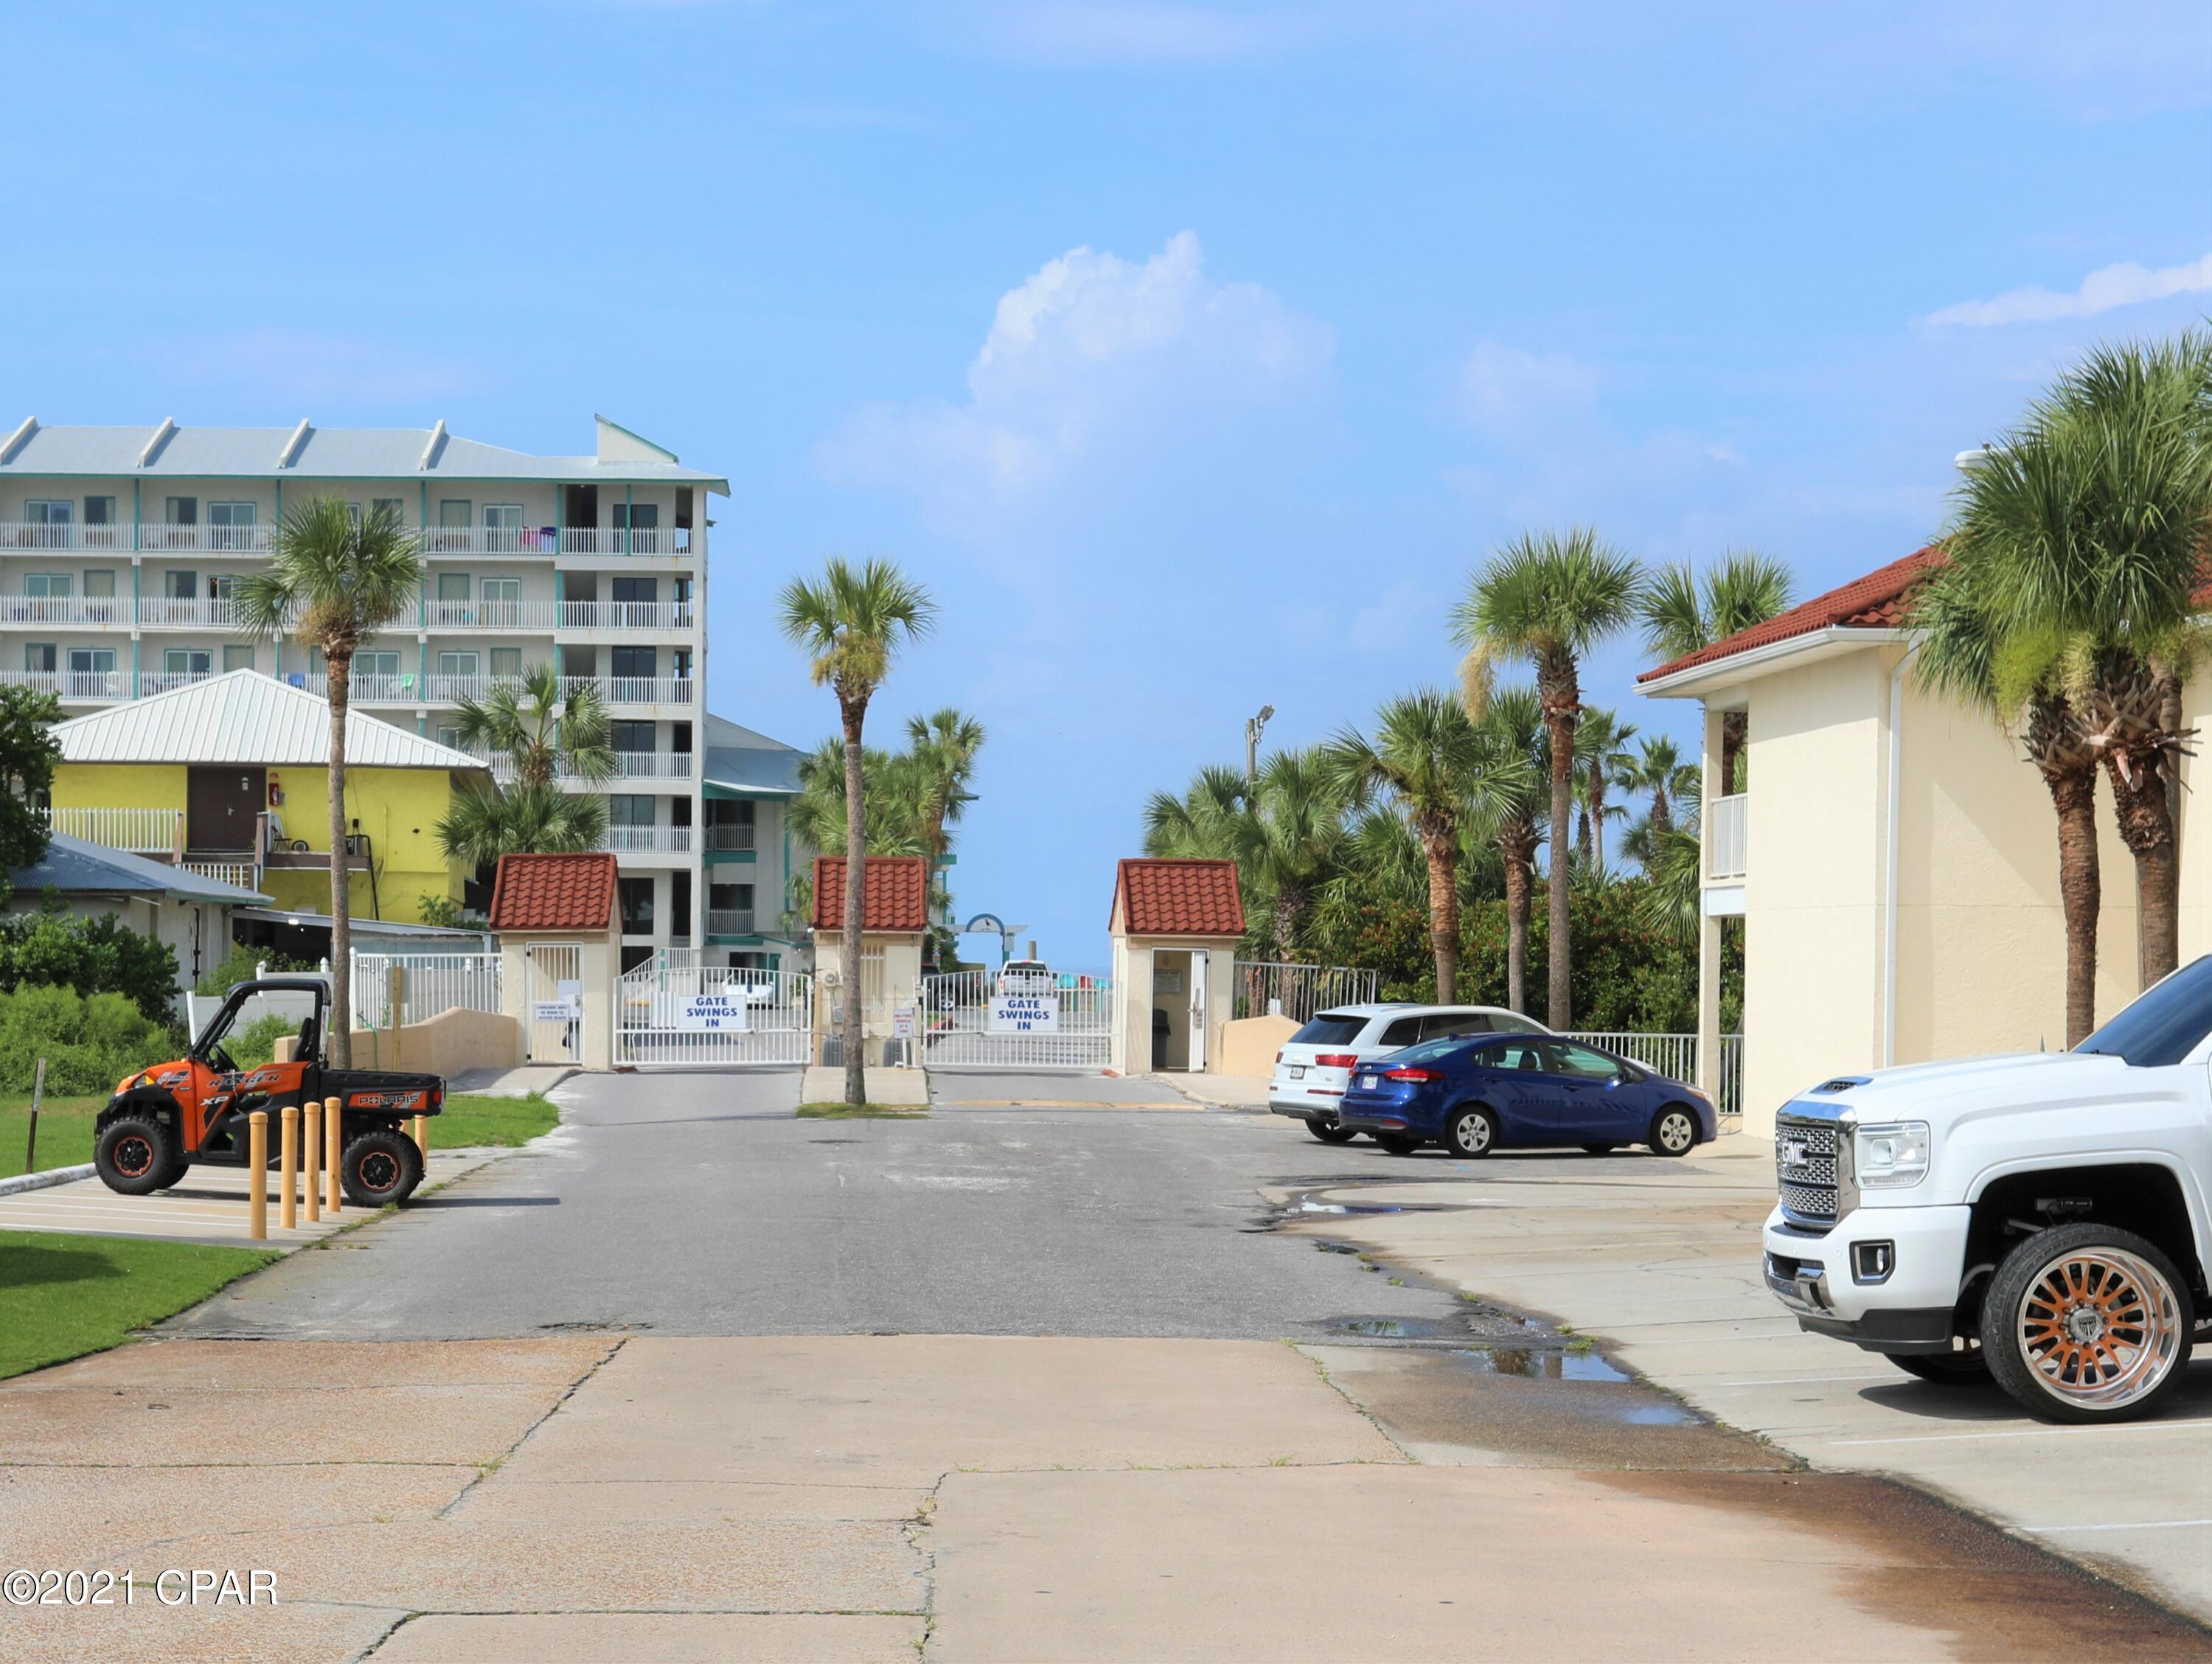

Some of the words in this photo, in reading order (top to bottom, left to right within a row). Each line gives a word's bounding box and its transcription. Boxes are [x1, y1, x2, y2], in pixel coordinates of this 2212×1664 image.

[696, 997, 728, 1006] GATE
[1008, 1000, 1040, 1009] GATE
[686, 1008, 737, 1017] SWINGS
[998, 1010, 1049, 1020] SWINGS
[706, 1019, 719, 1027] IN
[1018, 1021, 1031, 1030] IN
[207, 1074, 281, 1088] RANGER
[200, 1096, 229, 1106] XP
[358, 1094, 420, 1105] POLARIS
[1781, 1141, 1808, 1165] GMC
